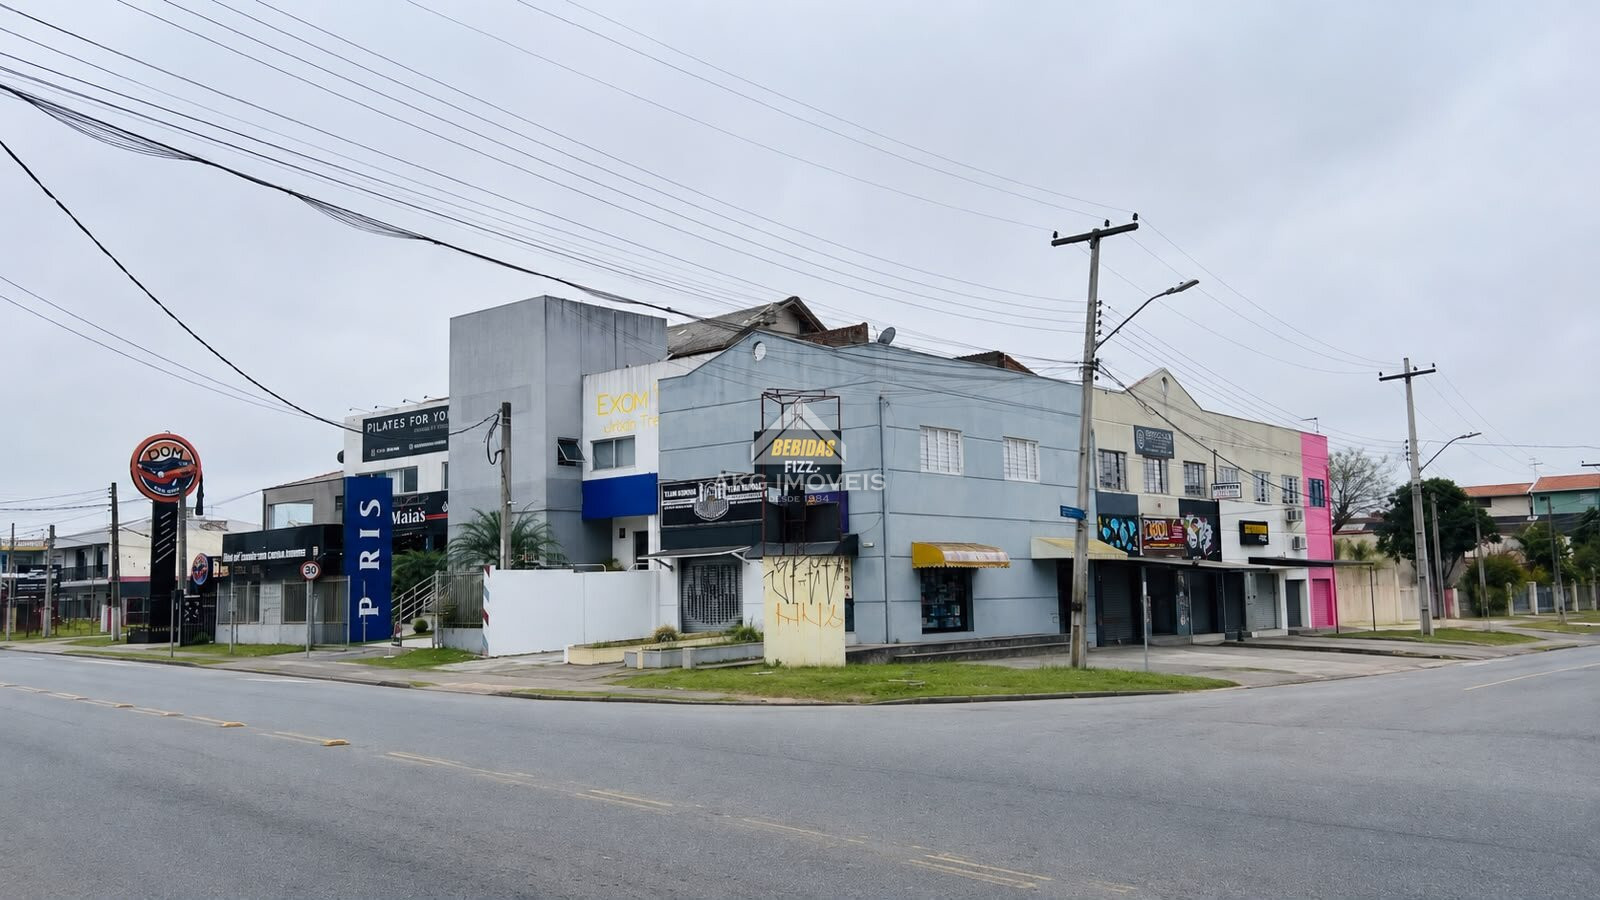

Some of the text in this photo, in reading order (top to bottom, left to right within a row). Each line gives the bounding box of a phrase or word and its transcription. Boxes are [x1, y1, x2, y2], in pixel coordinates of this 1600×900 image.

[367, 418, 405, 433] PILATES
[409, 413, 429, 427] FOR
[433, 410, 449, 422] YO
[148, 446, 184, 461] DOM
[771, 438, 836, 457] BEBIDAS
[305, 565, 317, 575] 30
